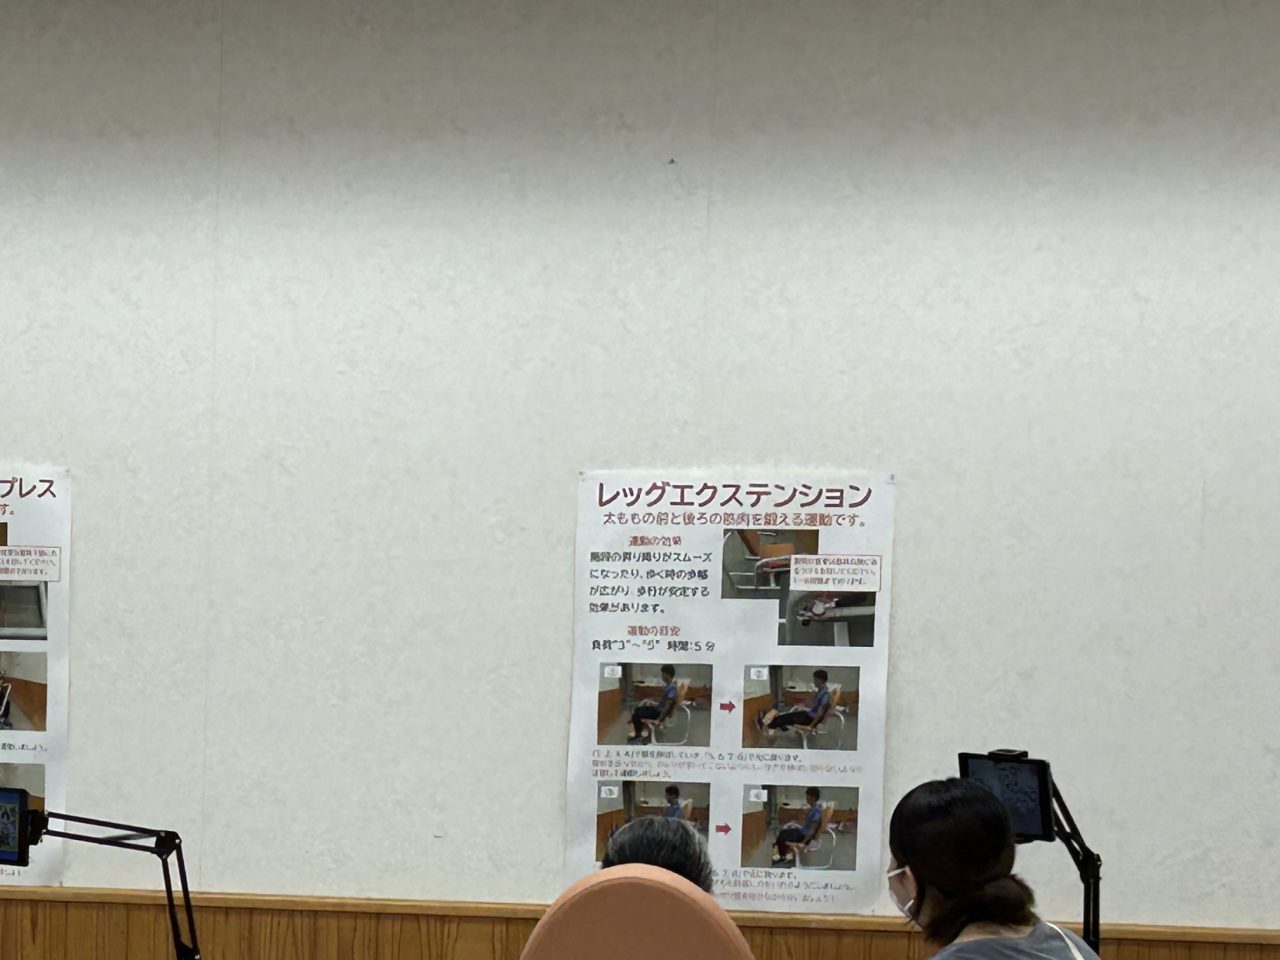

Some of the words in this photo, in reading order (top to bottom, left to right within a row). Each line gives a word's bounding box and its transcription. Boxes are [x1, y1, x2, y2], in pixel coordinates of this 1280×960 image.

[598, 481, 873, 507] レッグエクステンション
